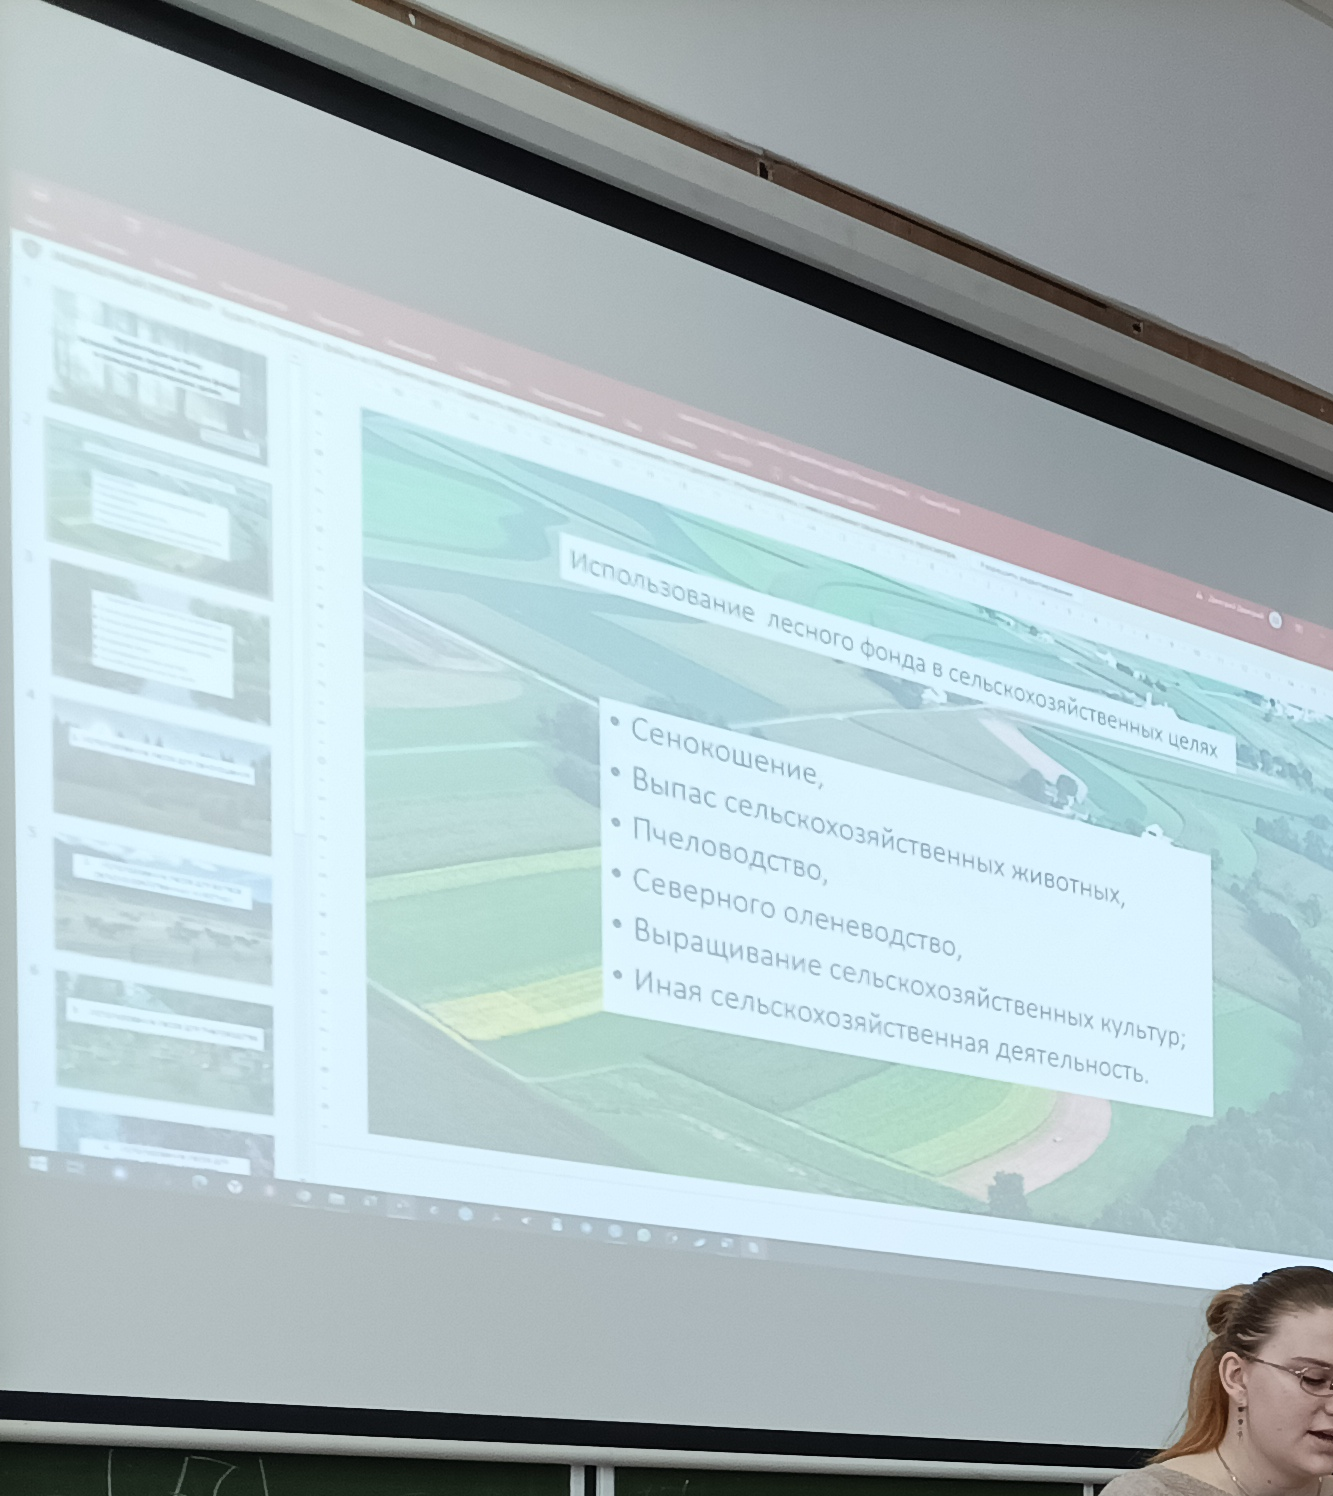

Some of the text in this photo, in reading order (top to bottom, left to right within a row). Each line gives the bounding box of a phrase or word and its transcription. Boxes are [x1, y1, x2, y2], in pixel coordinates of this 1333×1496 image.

[570, 549, 1218, 759] Использование лесного фонда в сельскохозяйственных целях
[631, 716, 825, 790] Сенокошение,
[633, 766, 1125, 910] Выпас сельскохозяйственных животных,
[633, 817, 828, 886] Пчеловодство,
[633, 868, 962, 962] Северного оленеводство,
[635, 917, 1186, 1051] Выращивание сельскохозяйственных культур;
[635, 968, 1150, 1085] Иная сельскохозяйственная деятельность.
